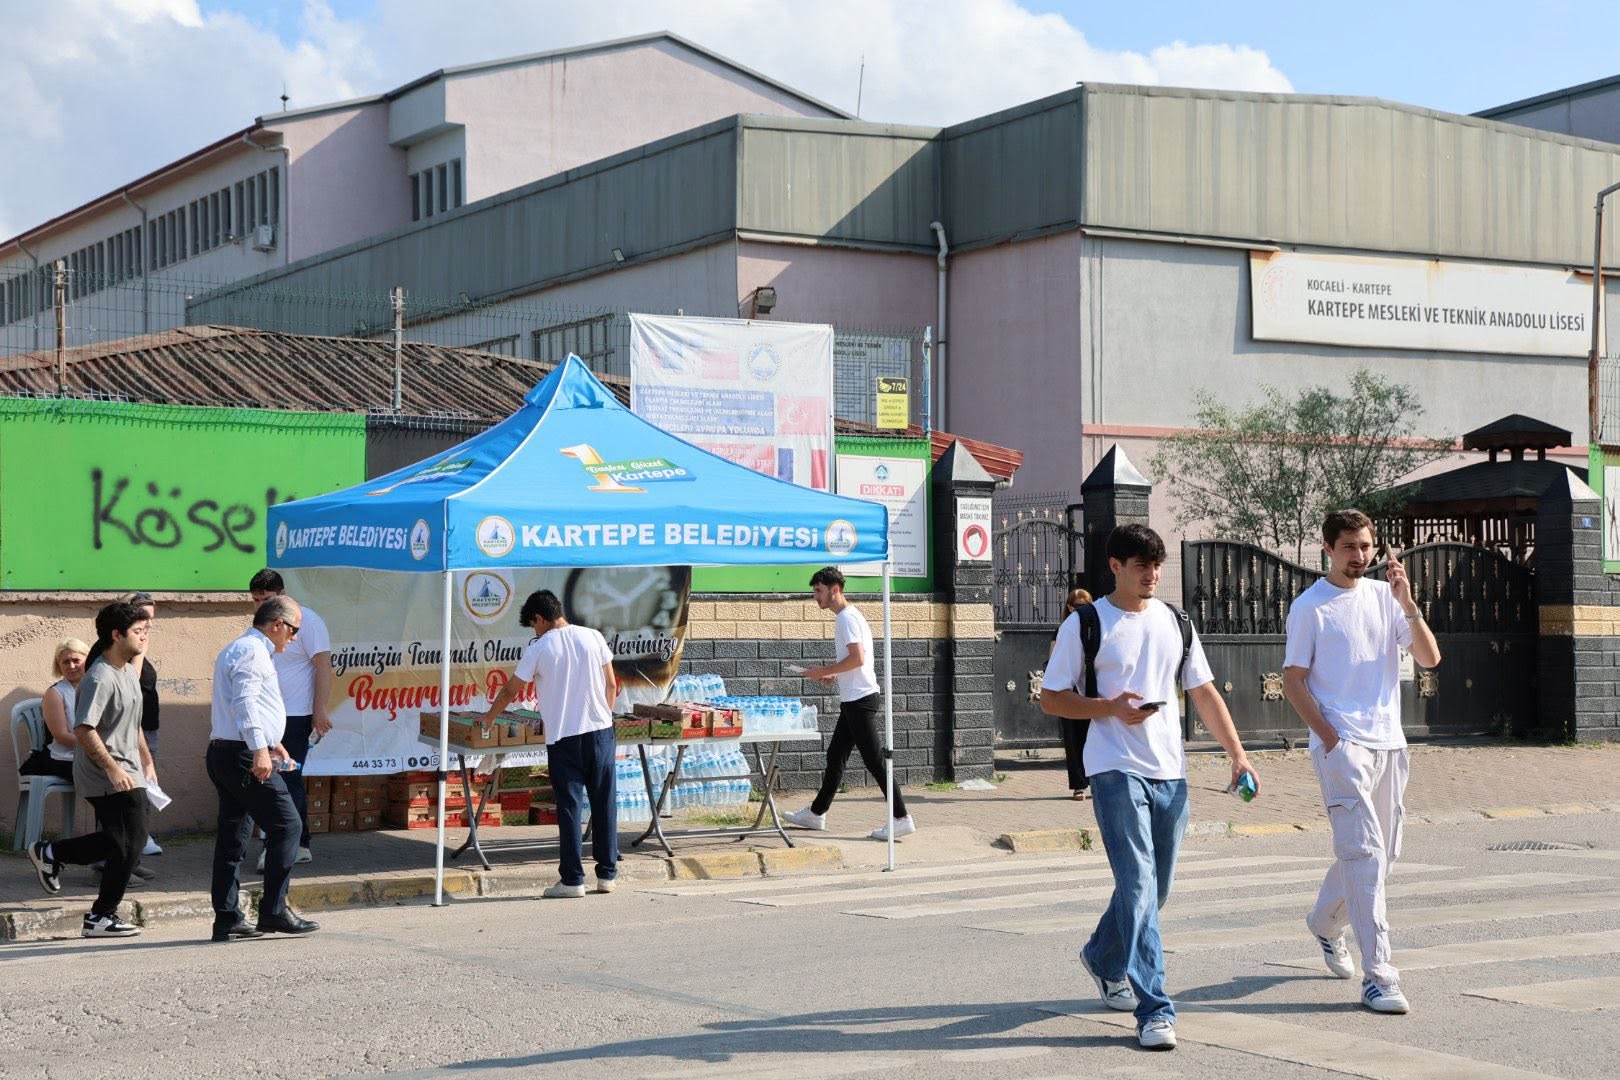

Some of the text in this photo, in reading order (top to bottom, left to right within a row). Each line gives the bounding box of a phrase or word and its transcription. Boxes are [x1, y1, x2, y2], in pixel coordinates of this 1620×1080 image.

[1307, 279, 1345, 293] KOCAELİ
[1352, 283, 1392, 296] KARTEPE
[1308, 299, 1585, 331] KARTEPE MESLEKİ VE TEKNİK ANADOLU LİSESİ
[891, 382, 906, 391] 7/24
[728, 426, 766, 435] YOLUNDA
[612, 467, 688, 482] Kartepe
[288, 526, 338, 549] KARTEPE
[521, 523, 656, 547] KARTEPE
[331, 646, 402, 677] eğimizin
[408, 641, 478, 665] Temnatı
[484, 639, 522, 662] Olan
[349, 673, 477, 721] Başarıar
[352, 758, 397, 769] 444 33 73
